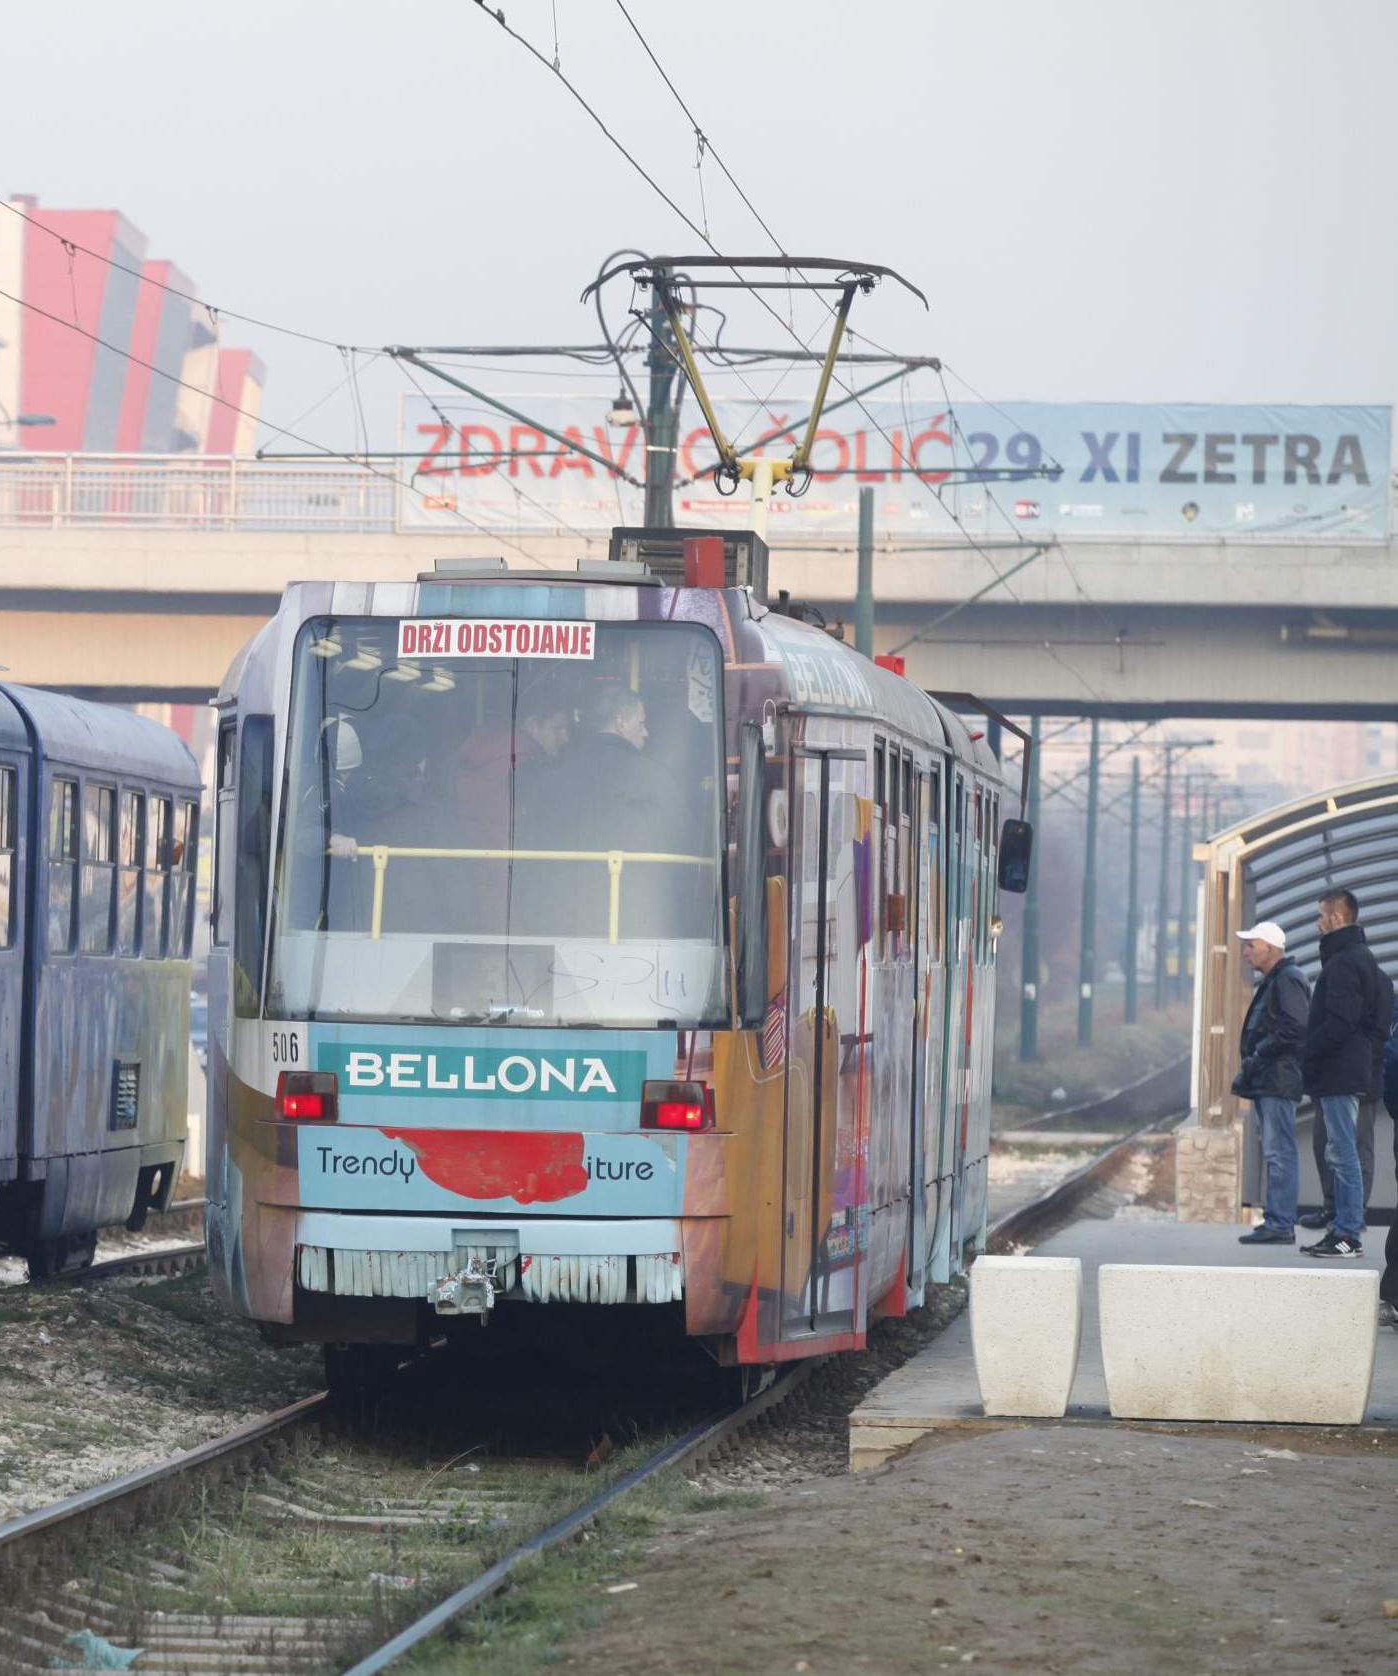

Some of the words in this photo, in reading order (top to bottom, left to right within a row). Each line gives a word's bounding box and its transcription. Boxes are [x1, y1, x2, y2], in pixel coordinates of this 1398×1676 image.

[416, 424, 732, 482] ZDRAVO
[1079, 431, 1141, 483] XI
[1159, 431, 1370, 486] ZETRA
[402, 622, 451, 654] DRŽI
[457, 624, 591, 655] ODSTOJANJE
[273, 1031, 299, 1063] 506
[345, 1051, 617, 1093] BELLONA
[317, 1147, 415, 1183] Trendy
[587, 1156, 654, 1181] iture
